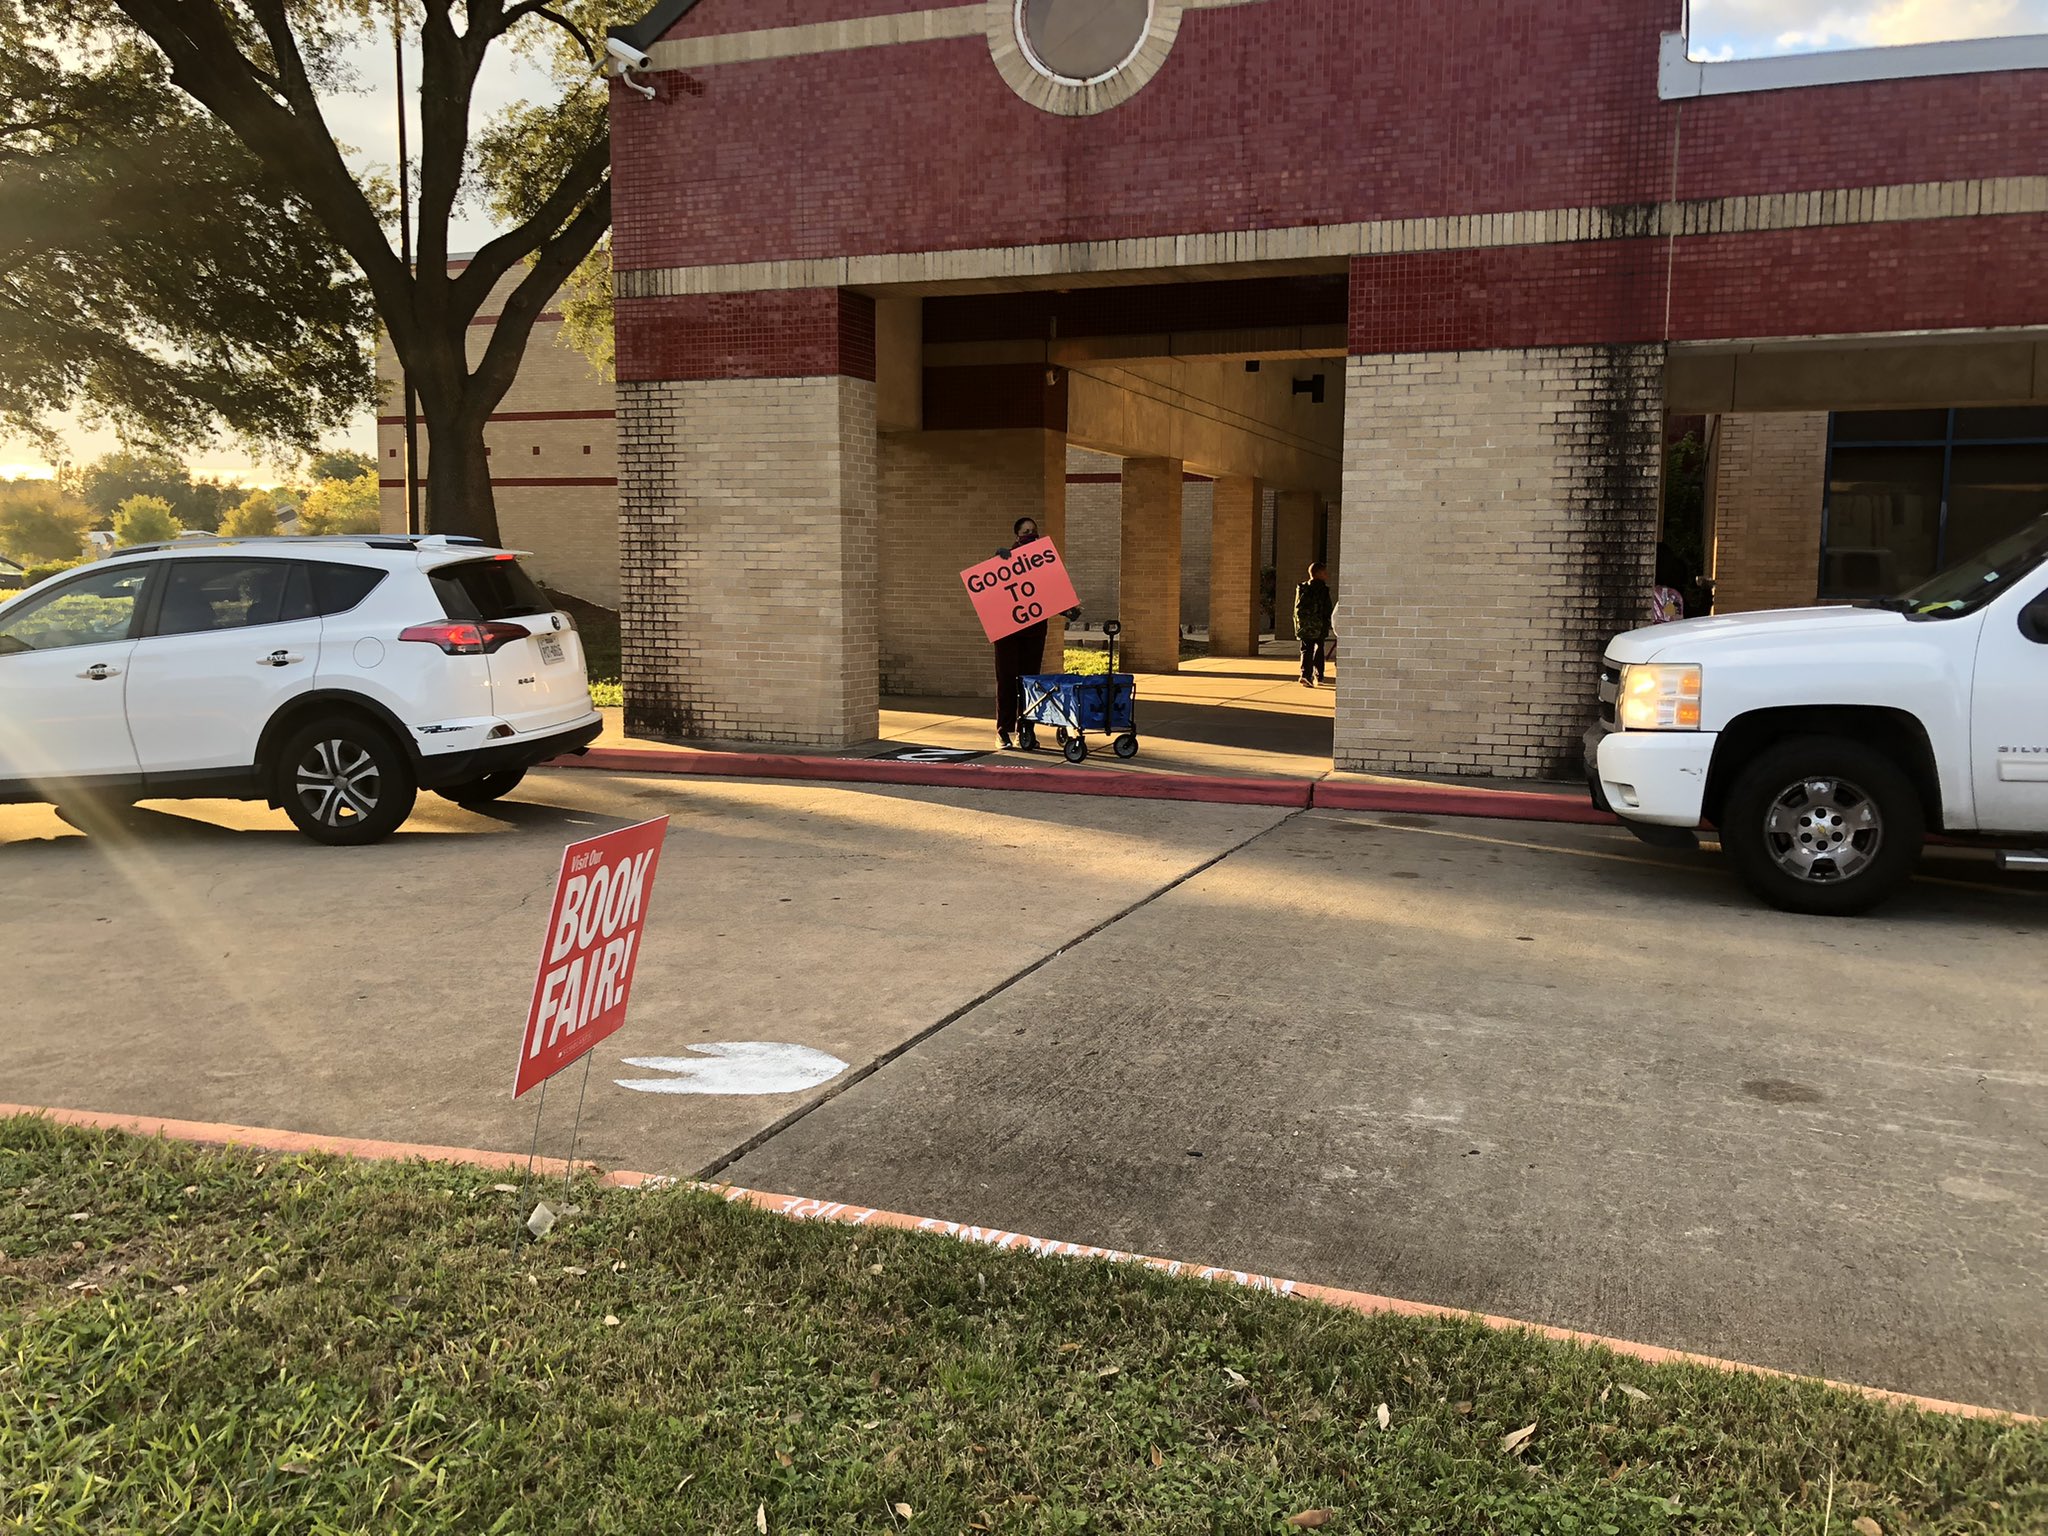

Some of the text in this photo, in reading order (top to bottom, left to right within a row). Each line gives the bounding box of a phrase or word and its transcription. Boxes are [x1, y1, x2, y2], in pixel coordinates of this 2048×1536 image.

[967, 549, 1056, 593] Goodies
[1004, 581, 1035, 602] TO
[1012, 602, 1043, 624] GO
[571, 849, 604, 873] Visit Our
[549, 848, 654, 965] BOOK
[529, 930, 636, 1059] FAIR!
